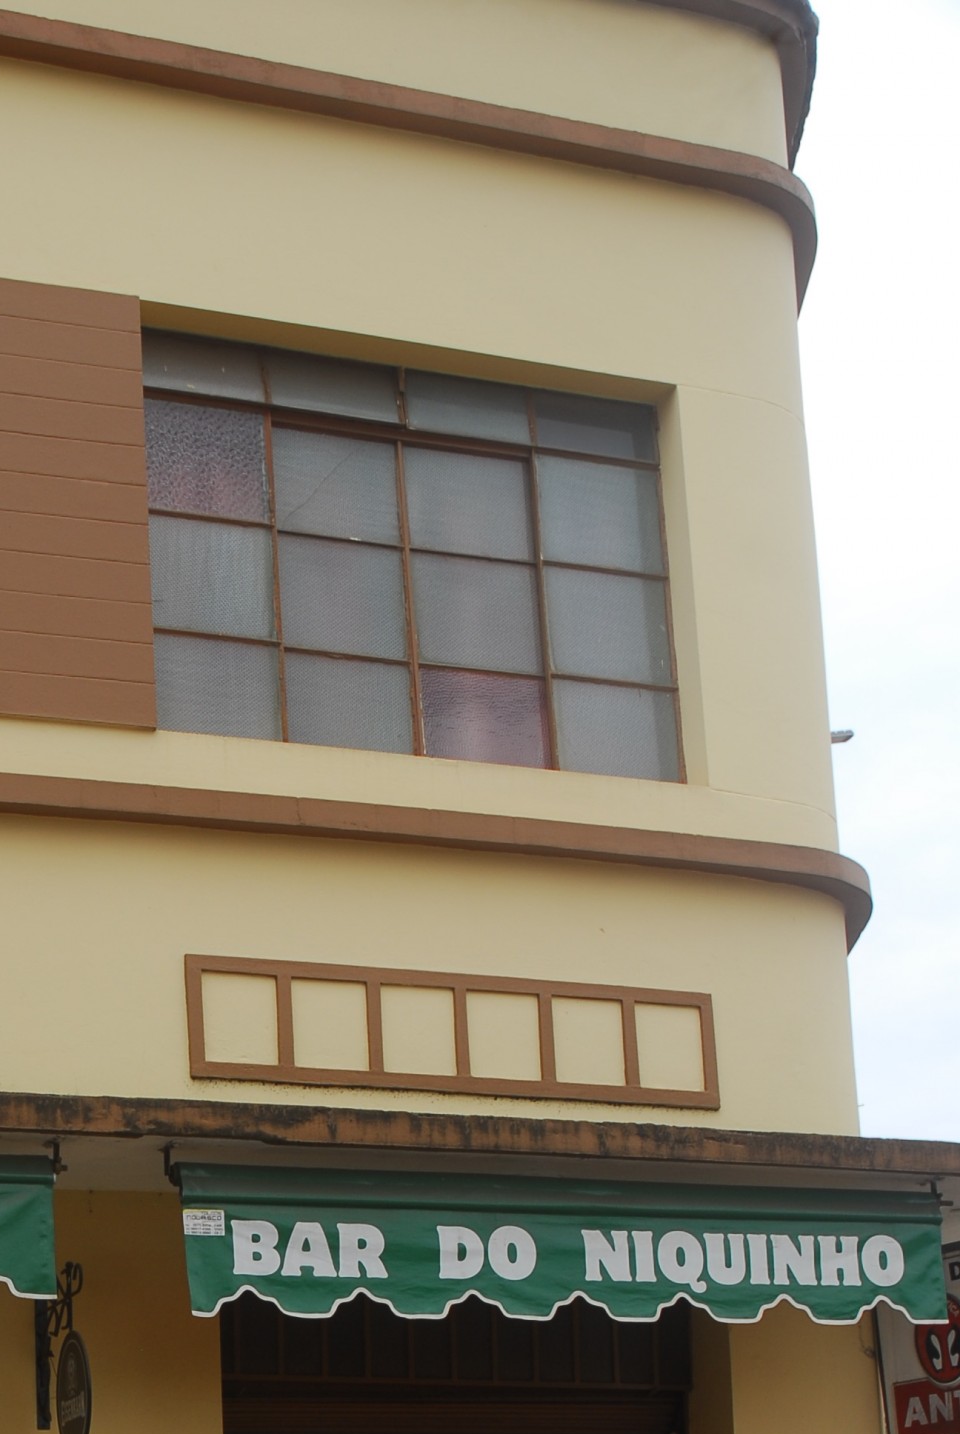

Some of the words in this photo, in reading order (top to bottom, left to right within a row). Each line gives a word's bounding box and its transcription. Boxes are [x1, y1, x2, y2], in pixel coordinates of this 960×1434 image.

[230, 1219, 388, 1279] BAR
[436, 1225, 537, 1281] DO
[581, 1229, 905, 1293] NIQUINHO
